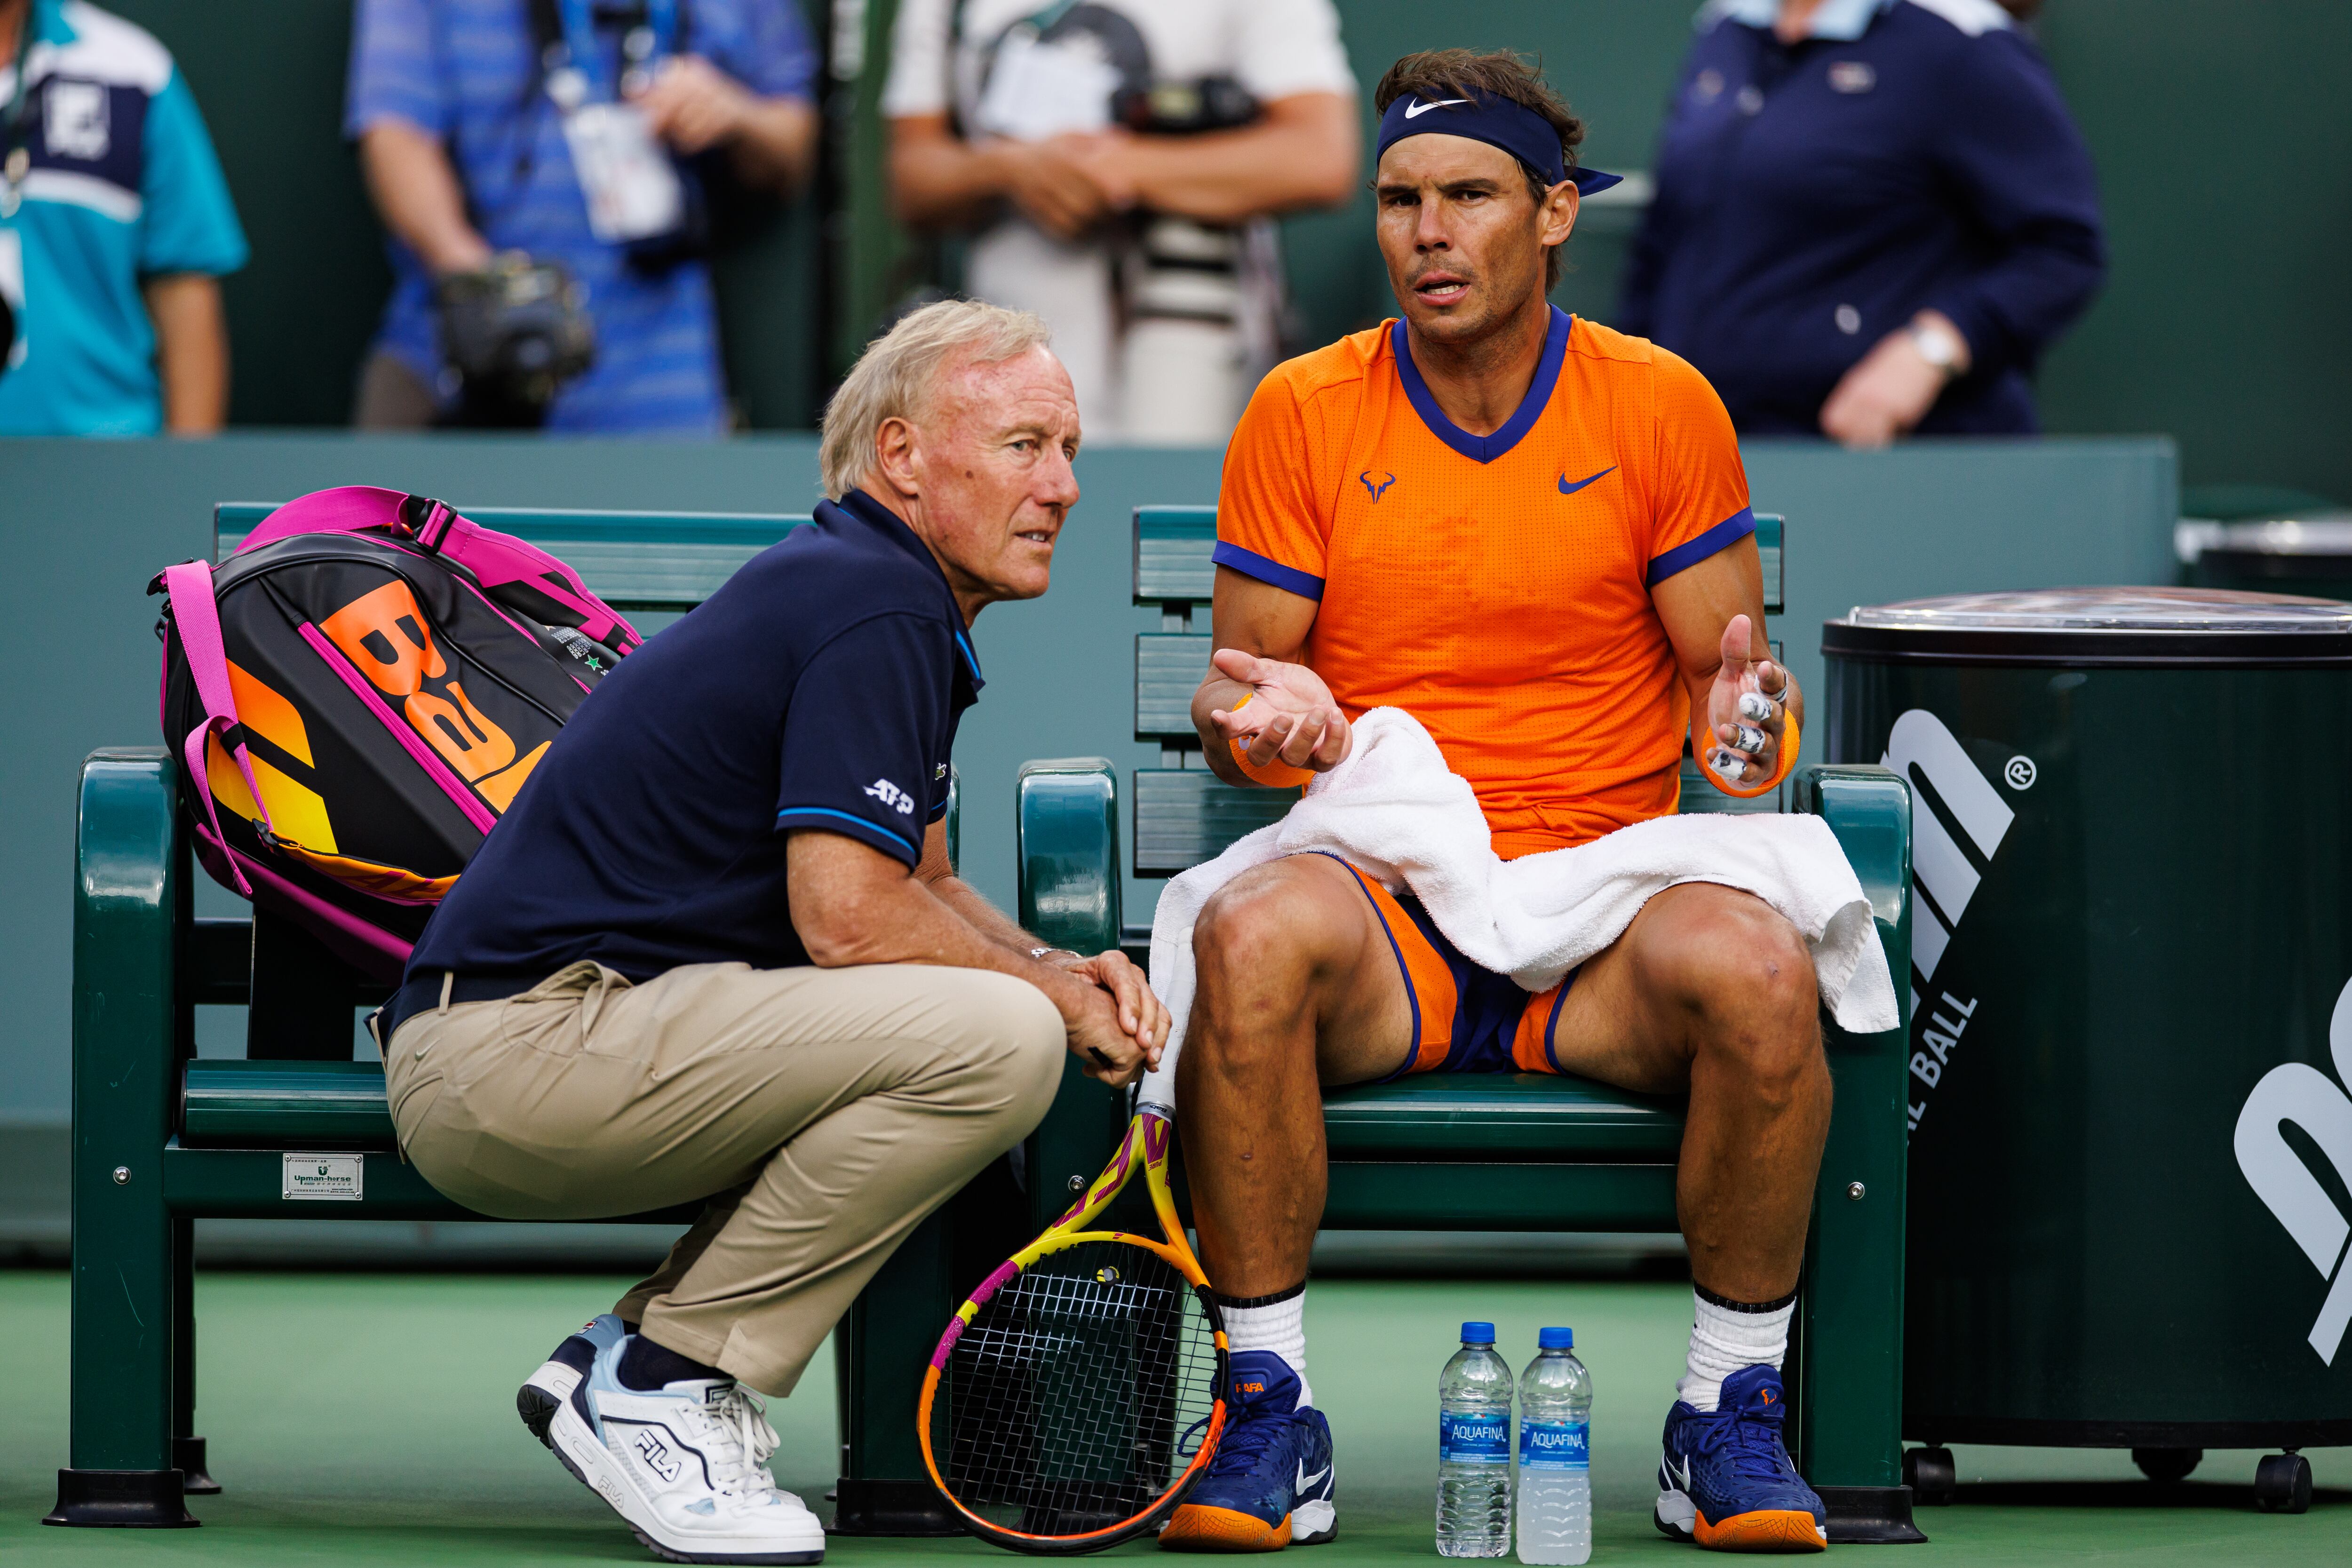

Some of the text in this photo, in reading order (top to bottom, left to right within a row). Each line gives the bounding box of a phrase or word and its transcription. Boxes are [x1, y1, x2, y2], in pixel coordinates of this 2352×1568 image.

[567, 645, 578, 659] 2005
[570, 644, 582, 657] 2006
[572, 642, 585, 655] 2007
[863, 778, 914, 814] ATP
[1909, 991, 1978, 1089] BALL
[1148, 1160, 1162, 1171] PURE
[294, 1175, 351, 1185] Upman-horse
[1235, 1382, 1264, 1393] RAFA
[1210, 1425, 1218, 1443] SPIN
[1452, 1425, 1505, 1442] AQUAFINA
[1531, 1432, 1584, 1449] AQUAFINA
[635, 1429, 681, 1482] FILA
[598, 1475, 624, 1509] FILA
